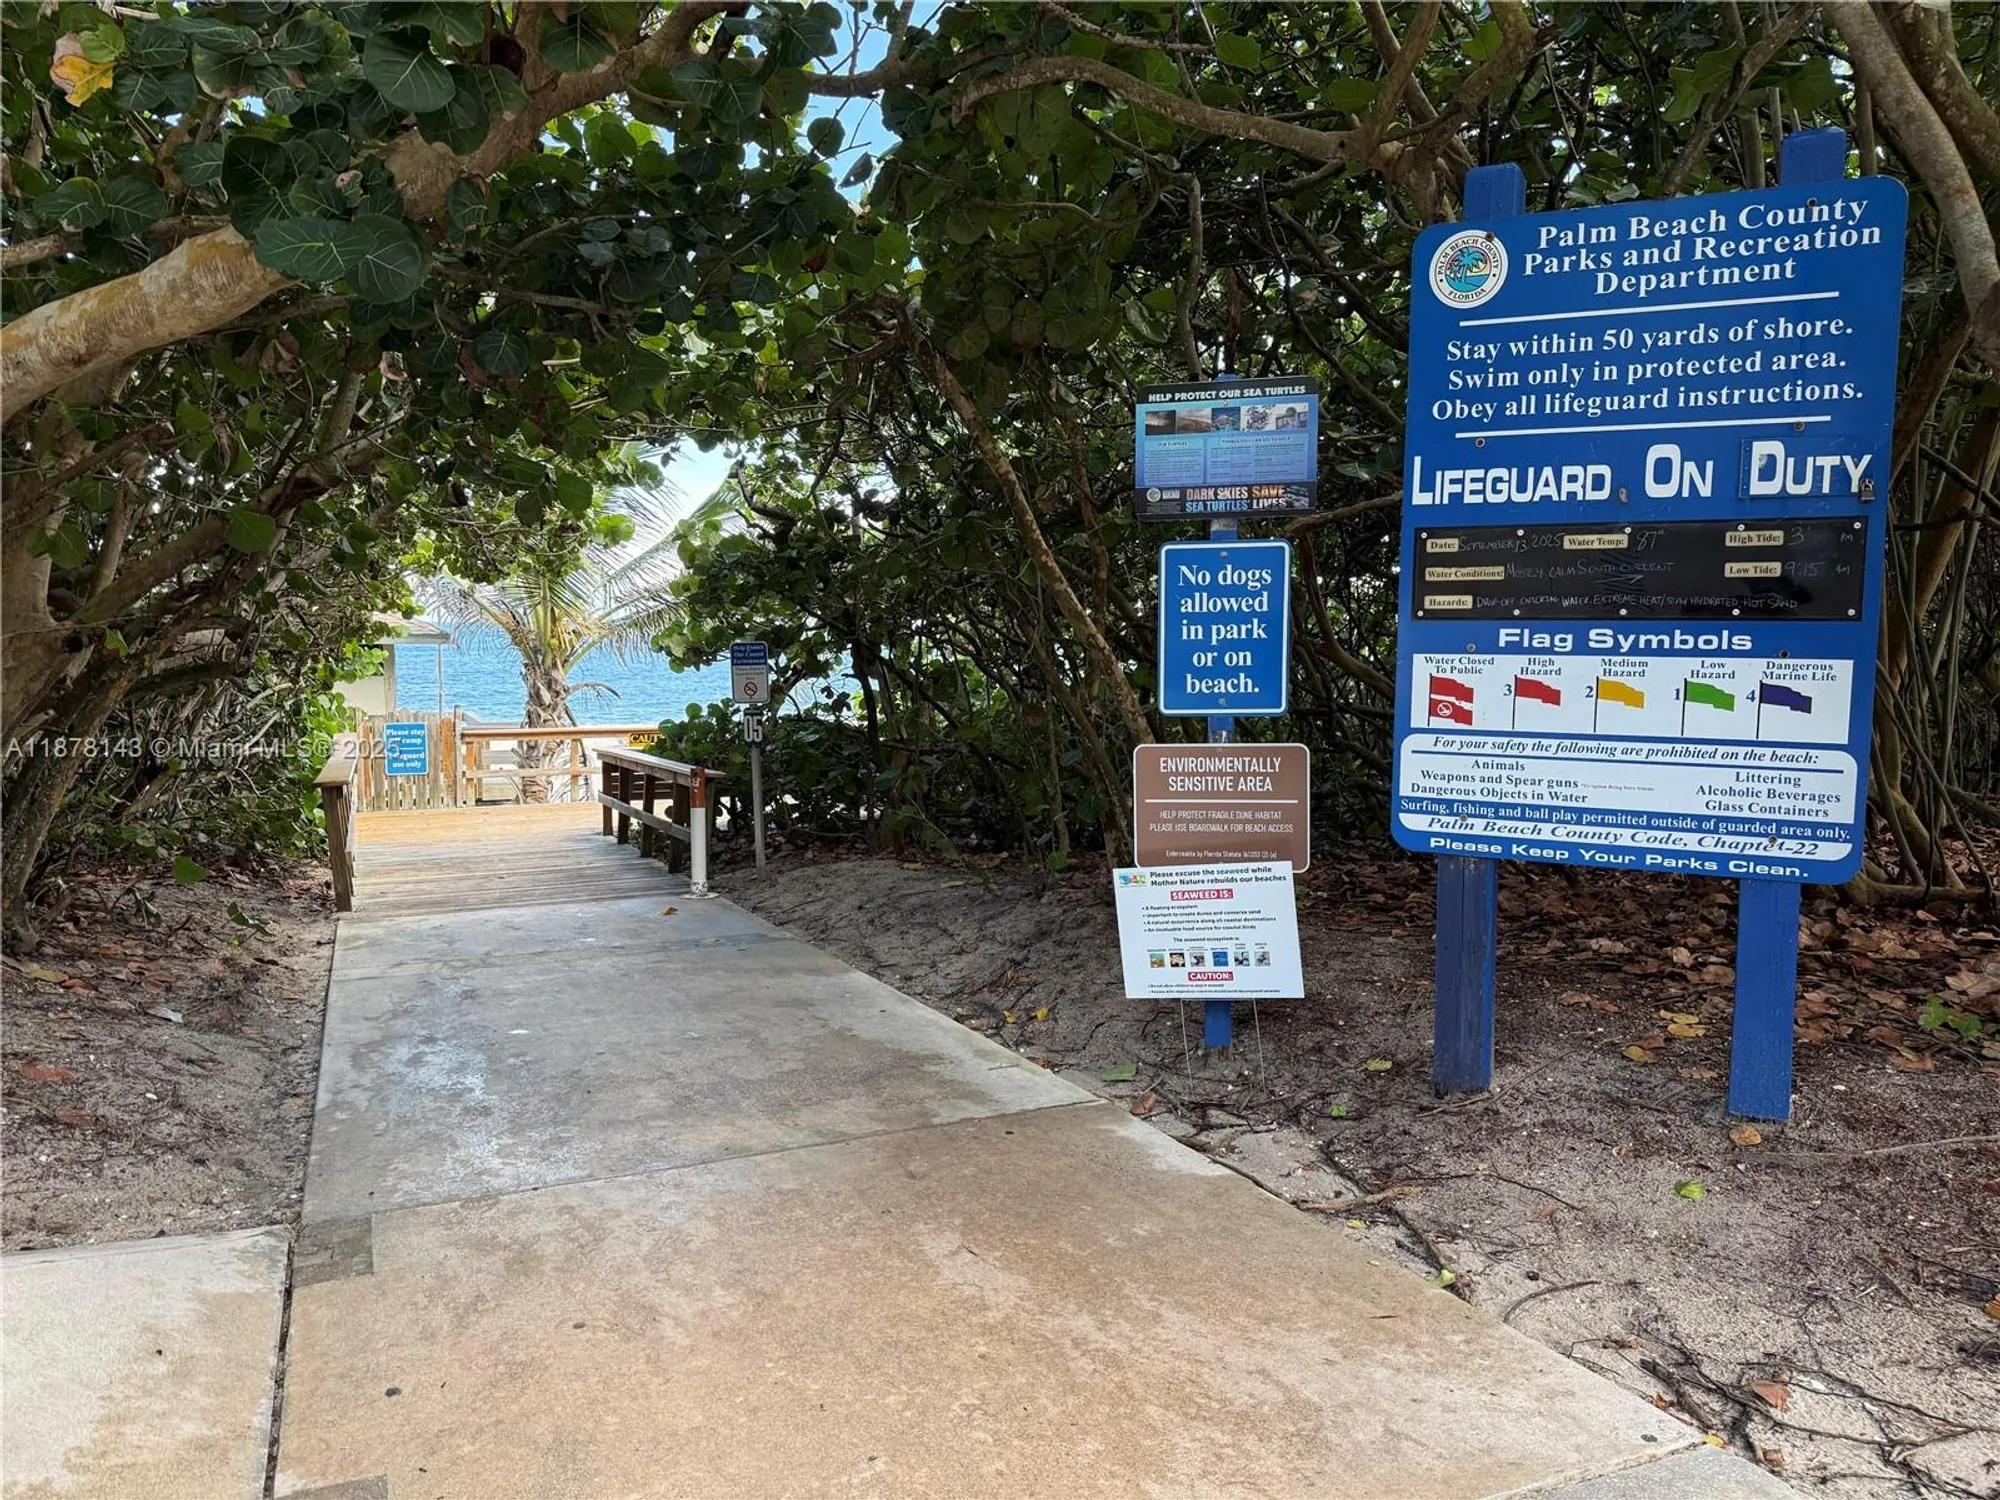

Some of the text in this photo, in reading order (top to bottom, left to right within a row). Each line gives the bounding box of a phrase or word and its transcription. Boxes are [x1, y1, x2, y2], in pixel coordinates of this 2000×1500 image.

[1539, 198, 1868, 249] Palm Beach County
[1524, 224, 1880, 275] Parks and Recreation
[1437, 238, 1499, 275] PALM BEACH COUNTY
[1594, 257, 1796, 298] Department
[1448, 288, 1487, 300] FLORIDA
[1447, 317, 1852, 364] Stay within 50 yards of shore.
[1449, 351, 1846, 390] Swim only in protected area.
[1148, 385, 1306, 402] HELP PROTECT OUR SEA TURTLES
[1432, 380, 1863, 423] Obey all lifeguard instructions.
[1186, 488, 1215, 501] DARK
[1217, 486, 1249, 500] SKIES
[1252, 485, 1286, 498] SAVE
[1186, 501, 1204, 512] SEA
[1252, 498, 1287, 510] LIVES
[1431, 542, 1455, 550] Date:
[1531, 534, 1561, 548] 2025
[1568, 537, 1624, 547] Water Temp:
[1729, 535, 1781, 544] High Tide:
[1427, 568, 1503, 578] Water Conditions:
[1729, 565, 1777, 574] Low Tide:
[1178, 564, 1272, 591] No dogs
[1180, 591, 1268, 613] allowed
[1429, 598, 1469, 606] Hazards:
[1182, 618, 1267, 645] in park
[1499, 628, 1752, 653] Flag Symbols
[1193, 651, 1252, 667] or on
[1424, 656, 1495, 666] Water Closed
[1528, 657, 1555, 667] High
[1601, 658, 1648, 668] Medium
[1701, 660, 1726, 669] Low
[1434, 665, 1483, 674] To Public
[1520, 666, 1561, 676] Hazard
[1603, 668, 1645, 677] Hazard
[1766, 661, 1833, 671] Dangerous
[1690, 670, 1735, 679] Hazard
[1762, 671, 1837, 681] Marine Life
[1186, 673, 1259, 694] beach.
[1503, 684, 1512, 696] 3
[1585, 685, 1594, 698] 2
[1675, 688, 1680, 700] 1
[1746, 690, 1756, 702] 4
[410, 729, 424, 737] stay
[744, 715, 762, 742] 05
[630, 734, 659, 742] CAUT
[1433, 736, 1819, 764] For your safety the following are prohibited on the beach:
[1160, 757, 1281, 772] ENVIRONMENTALLY
[1471, 759, 1525, 771] Animals
[1169, 776, 1272, 791] SENSITIVE AREA
[1421, 770, 1476, 784] Weapons
[1479, 774, 1502, 784] and
[1506, 774, 1544, 788] Spear
[1547, 779, 1578, 789] guns
[1735, 771, 1801, 788] Littering
[1411, 783, 1588, 803] Dangerous Objects in Water
[1696, 785, 1841, 804] Alcoholic Beverages
[1160, 810, 1281, 820] HELP PROTECT FRAGILE DUNE HABITAT
[1705, 800, 1829, 817] Glass Containers
[1401, 799, 1850, 842] Surfing, fishing and ball play permitted outside of guarded area only.
[1150, 823, 1293, 833] PLEASE USE BOARDWALK FOR BEACH ACCESS
[1428, 817, 1475, 831] Palm
[1483, 821, 1542, 835] Beach
[1551, 826, 1623, 844] County
[1630, 832, 1687, 847] Code,
[1430, 837, 1808, 877] Please Keep Your Parks Clean.
[1216, 867, 1249, 875] seaweed
[1207, 876, 1238, 884] rebuilds
[1172, 890, 1231, 900] SEAWEED IS:
[1190, 972, 1231, 980] CAUTION:
